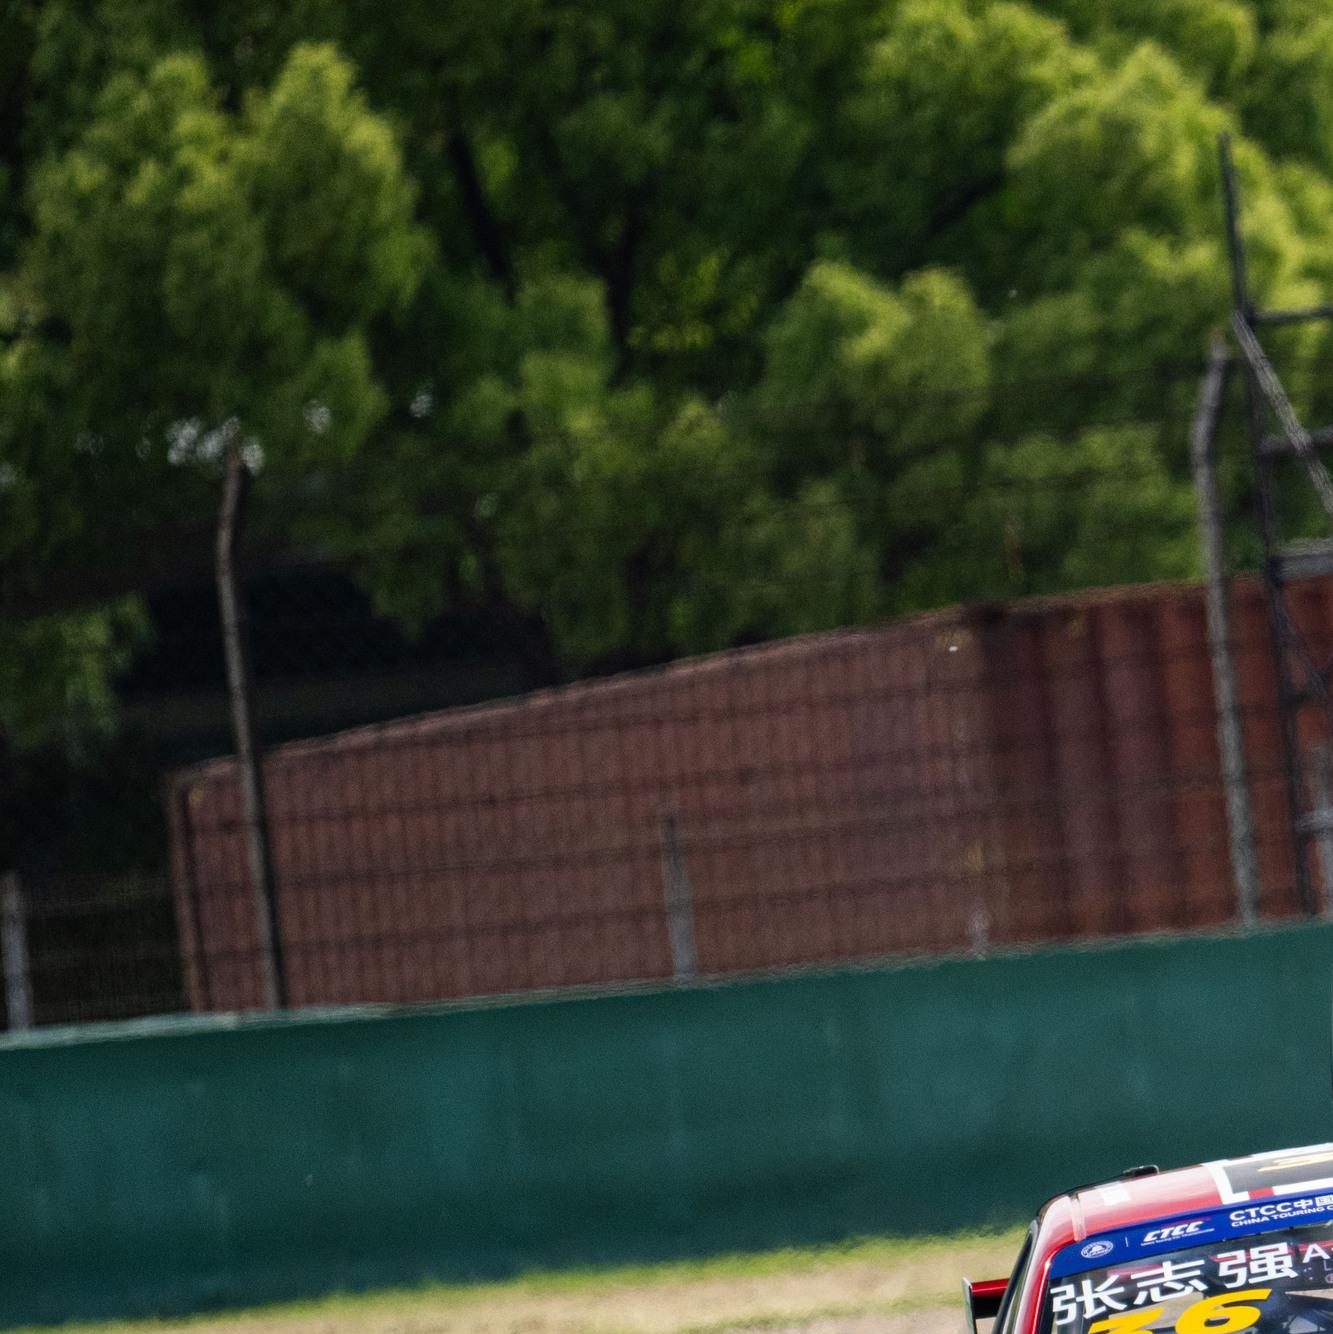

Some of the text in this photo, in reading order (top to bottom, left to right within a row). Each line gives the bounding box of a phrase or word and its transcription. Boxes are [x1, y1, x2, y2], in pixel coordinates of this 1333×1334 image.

[1231, 1216, 1271, 1228] CHINA
[1272, 1206, 1326, 1221] TOURING
[1143, 1220, 1204, 1243] CTCC
[1050, 1241, 1298, 1326] 张志强
